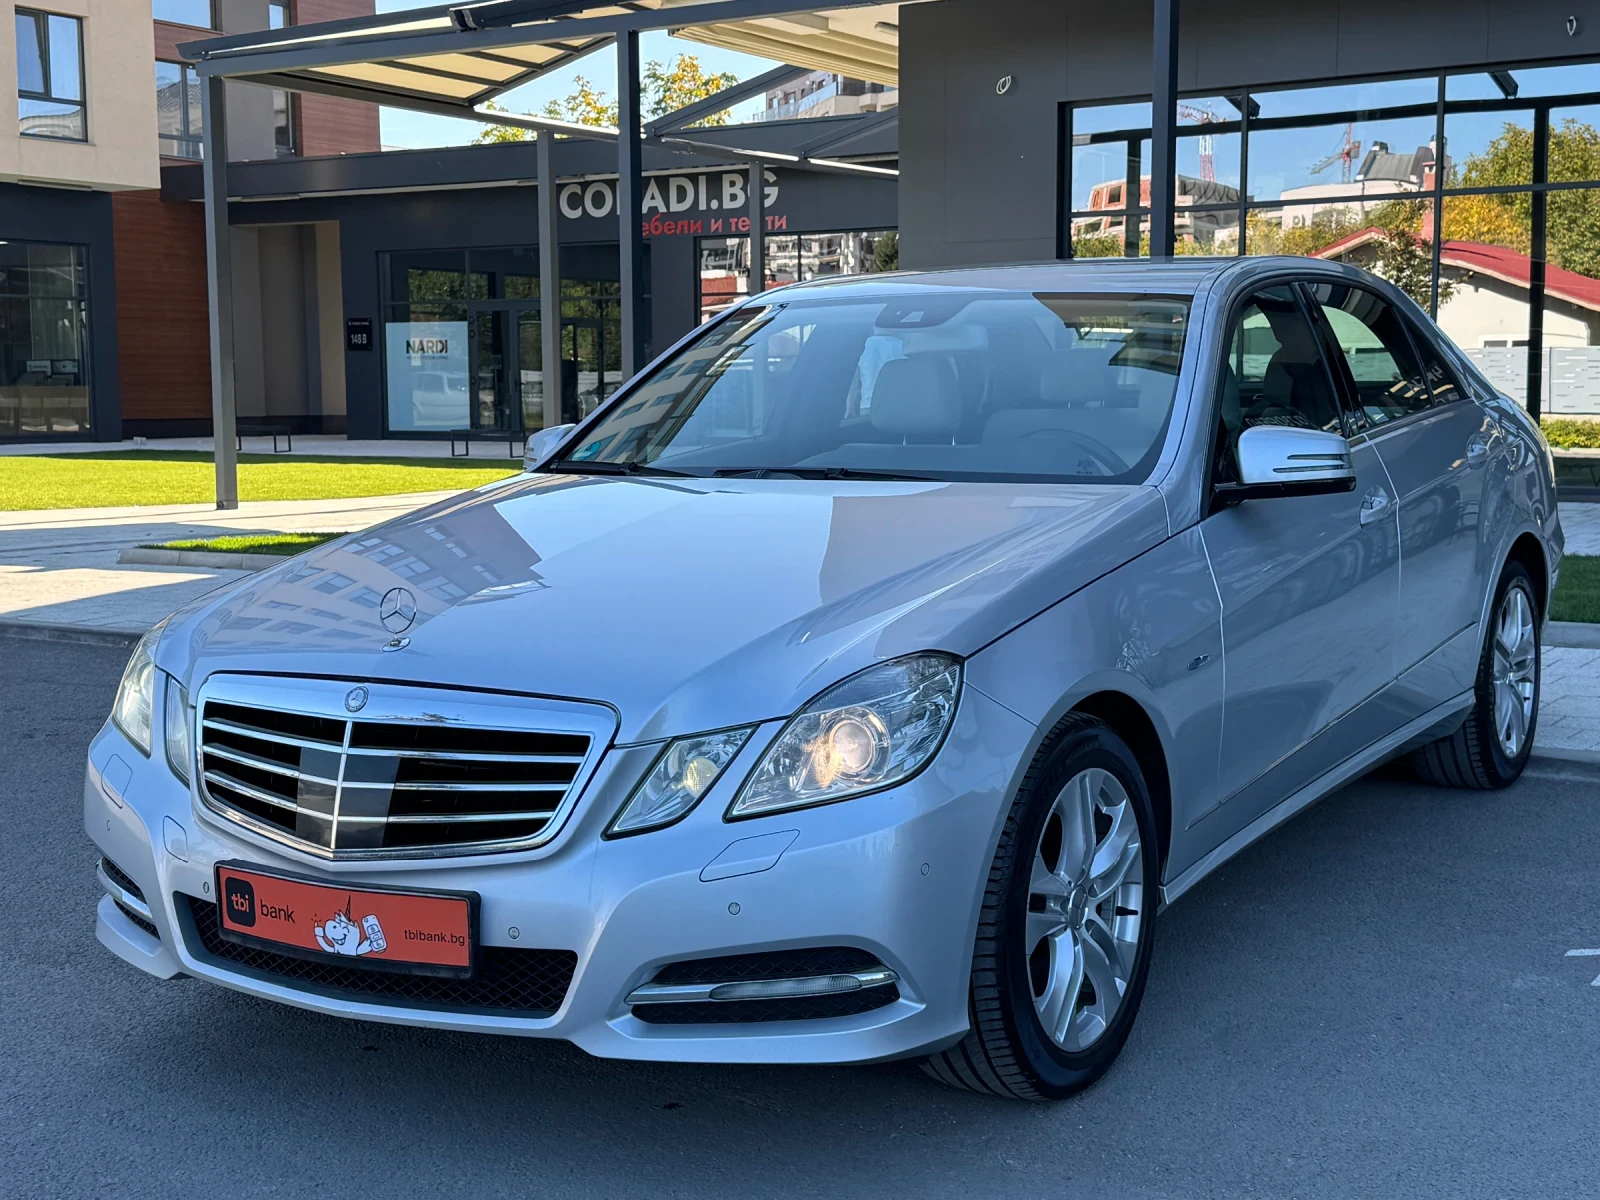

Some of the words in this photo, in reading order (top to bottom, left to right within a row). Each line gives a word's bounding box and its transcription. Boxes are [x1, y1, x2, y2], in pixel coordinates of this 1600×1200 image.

[559, 170, 779, 219] COADI.BG
[642, 212, 703, 238] ебели
[710, 218, 723, 234] и
[729, 215, 787, 233] тети
[405, 339, 449, 355] NARDI
[231, 892, 250, 913] tbi
[259, 898, 296, 924] bank
[403, 928, 466, 947] tbibank.bg
